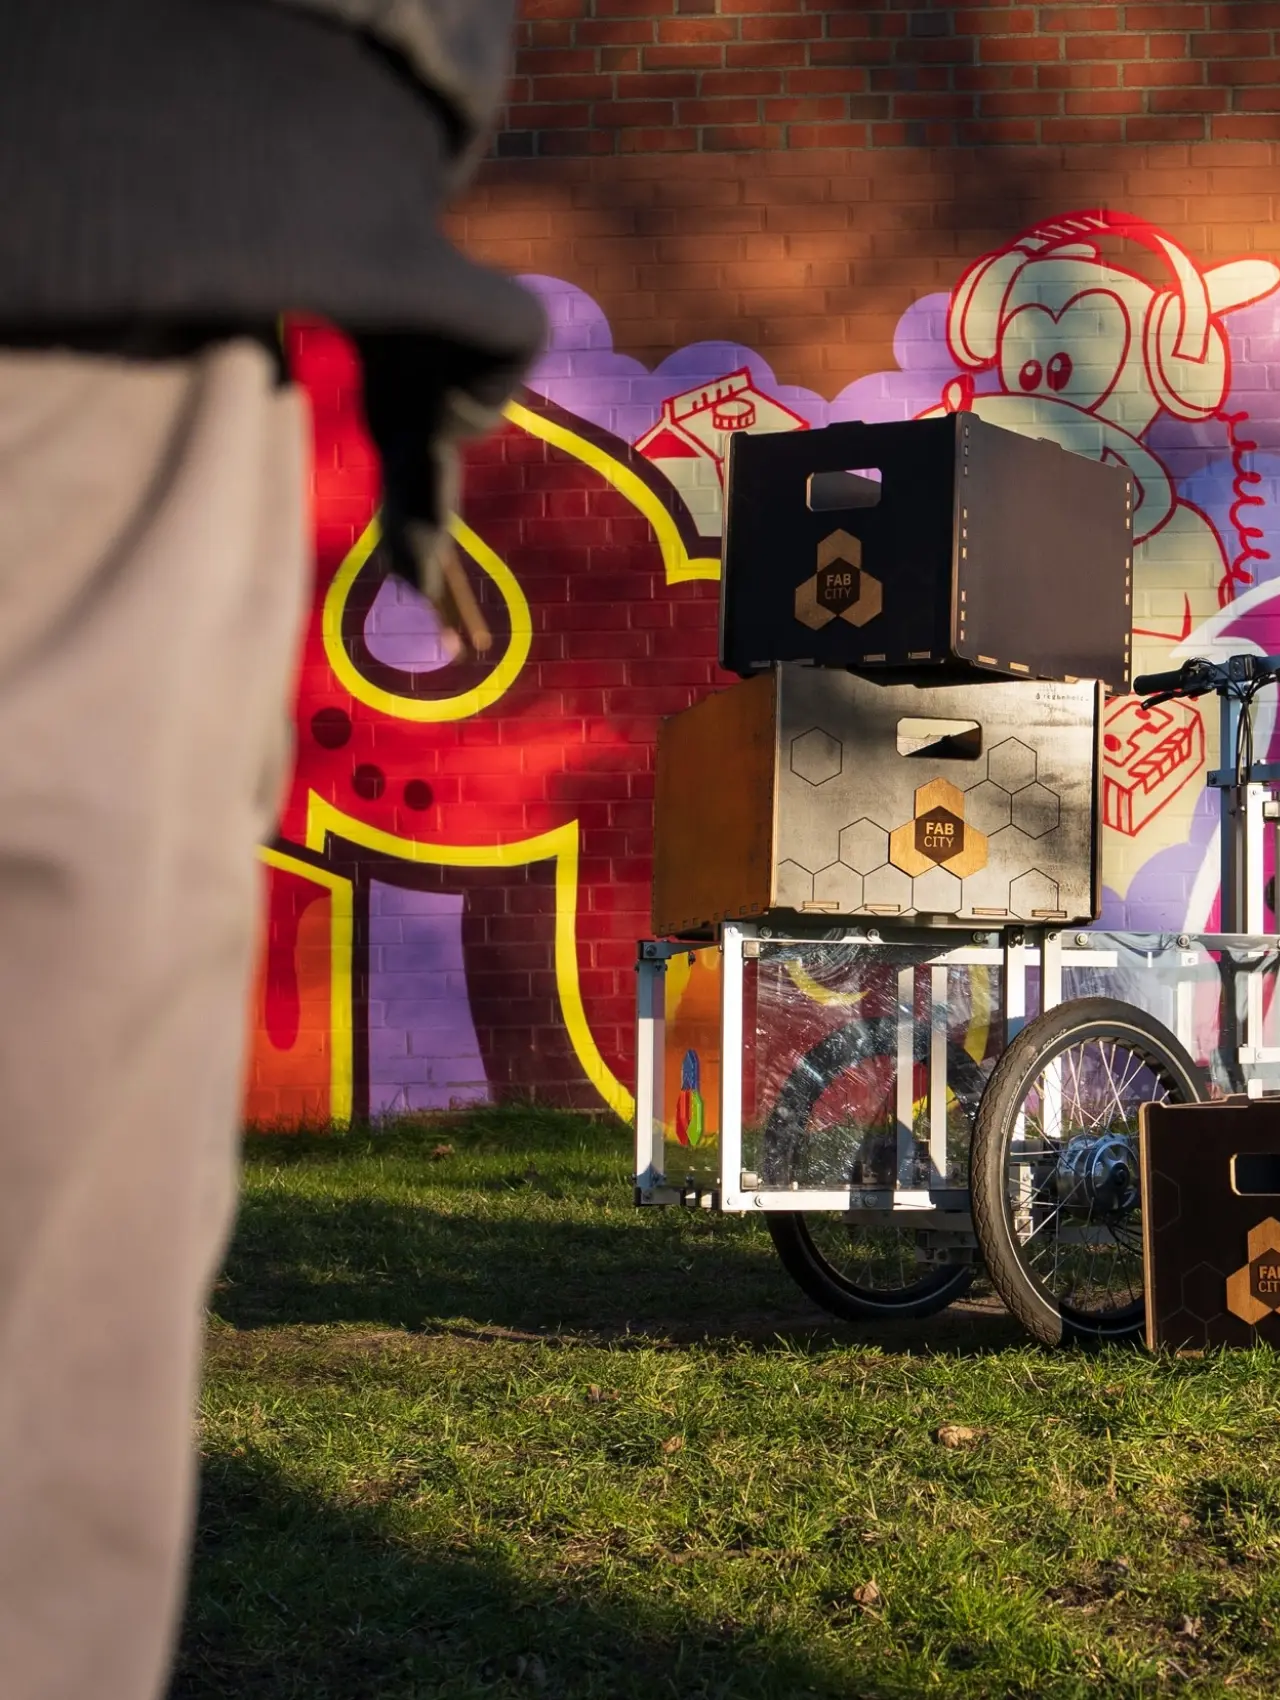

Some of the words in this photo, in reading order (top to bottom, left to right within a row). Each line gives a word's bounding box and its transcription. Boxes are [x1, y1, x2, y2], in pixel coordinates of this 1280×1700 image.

[826, 573, 852, 587] FAB
[824, 586, 852, 600] CITY
[926, 821, 954, 835] FAB
[923, 835, 954, 848] CITY
